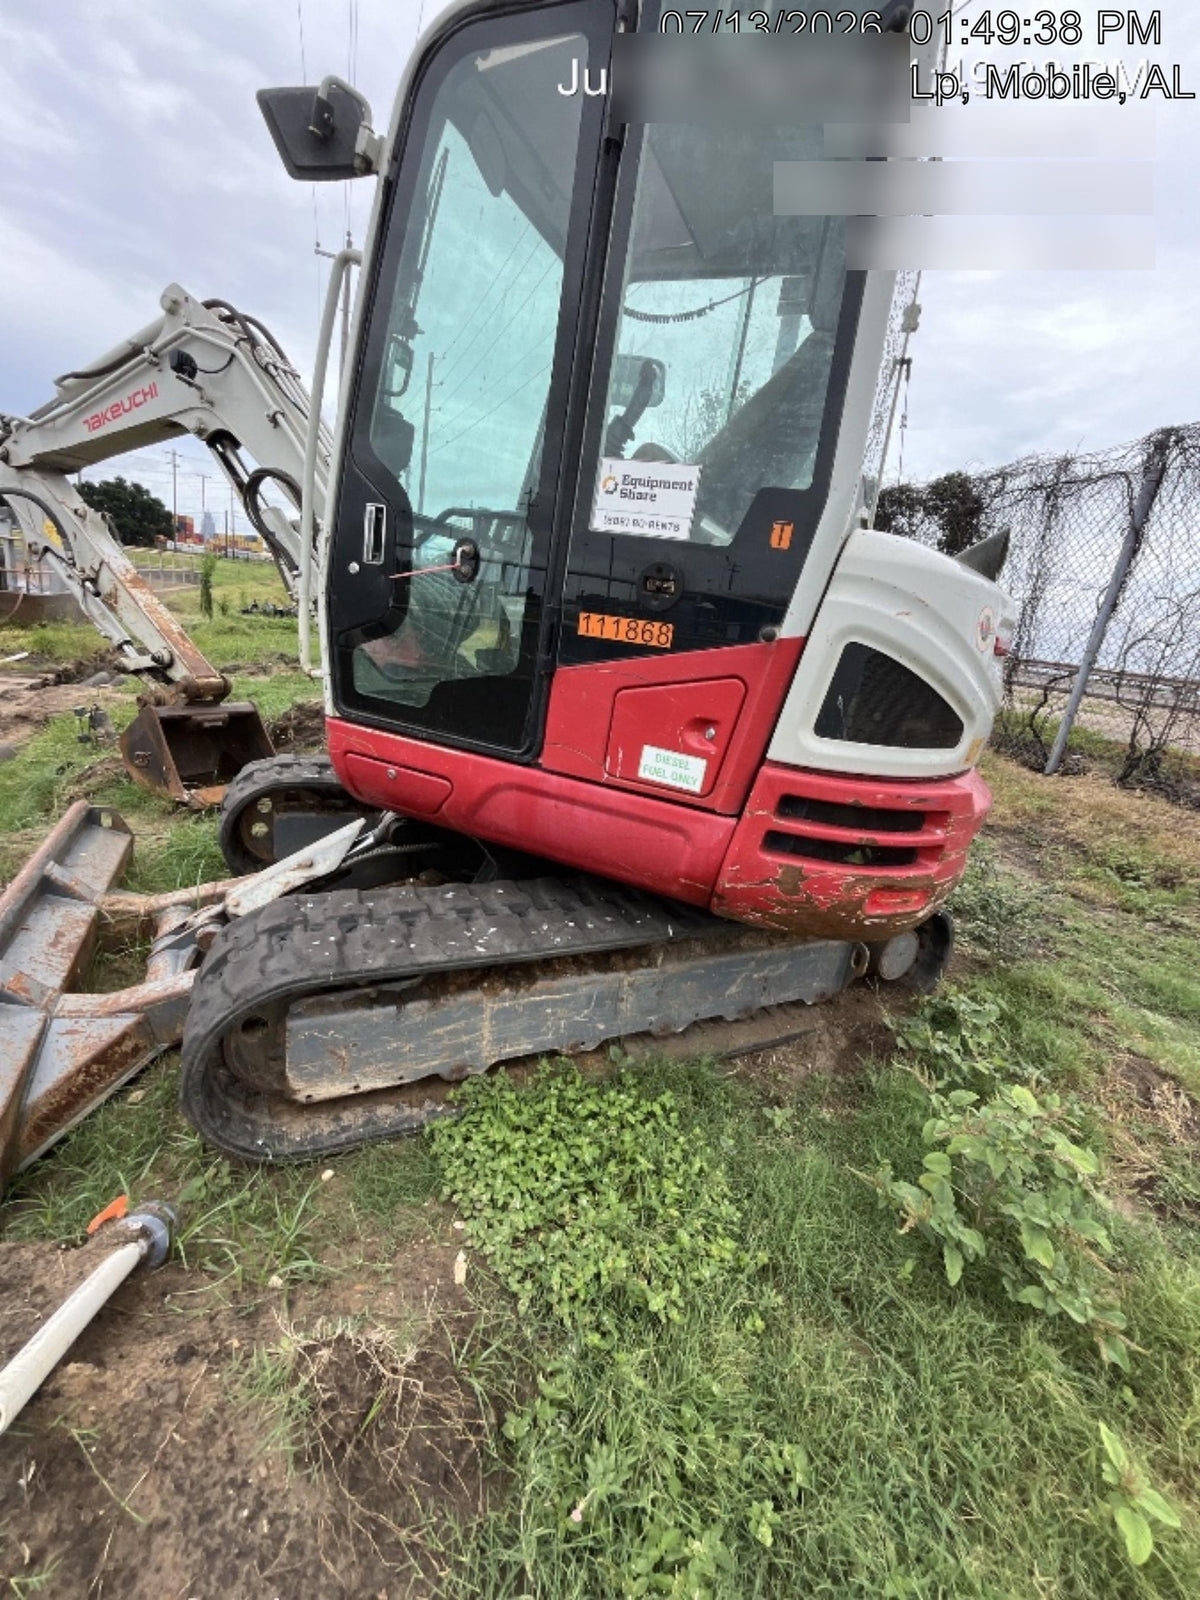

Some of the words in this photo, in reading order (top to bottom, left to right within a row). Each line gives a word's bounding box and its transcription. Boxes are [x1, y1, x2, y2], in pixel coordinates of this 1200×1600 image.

[621, 474, 694, 492] Equipment
[619, 488, 657, 502] Share
[582, 613, 672, 646] 111868
[655, 753, 691, 771] DIESEL
[642, 763, 668, 780] FUEL
[671, 770, 698, 787] ONLY
